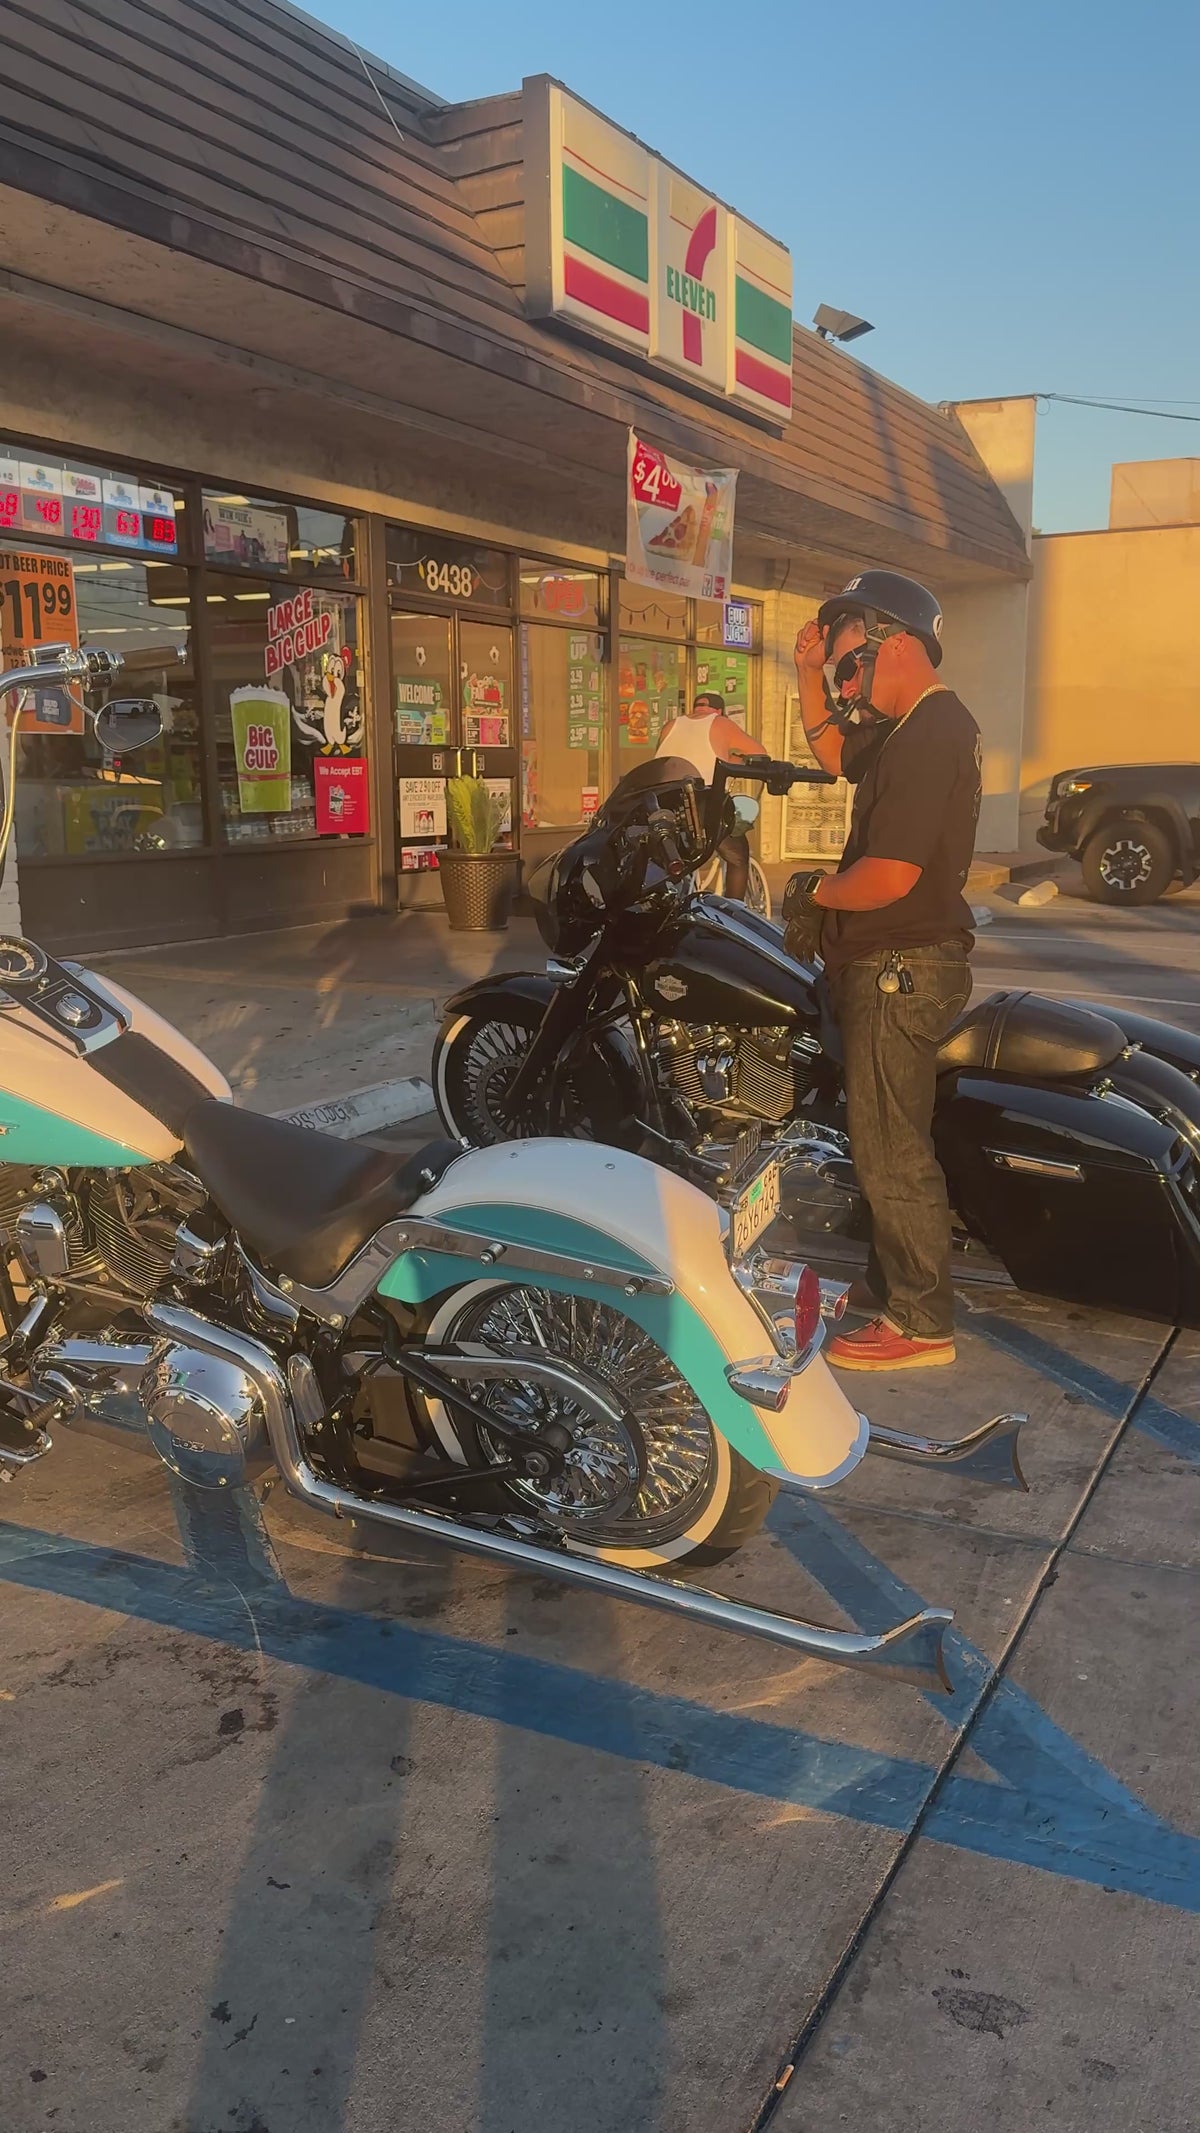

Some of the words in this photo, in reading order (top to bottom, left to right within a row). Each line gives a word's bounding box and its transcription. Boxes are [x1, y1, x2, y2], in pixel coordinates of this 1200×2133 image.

[683, 206, 717, 367] 7
[36, 499, 60, 523] 48
[72, 506, 101, 530] 130
[116, 510, 140, 538] 63
[14, 556, 38, 573] BEER
[40, 558, 70, 578] PRICE
[426, 559, 473, 598] 8438
[267, 588, 314, 642] LARGE
[727, 607, 748, 625] BUD
[264, 634, 295, 678] BIG
[293, 611, 332, 659] GULP
[725, 624, 750, 643] LIGHT
[399, 683, 435, 705] WELCOME
[244, 748, 279, 769] GULP
[330, 766, 351, 778] Accept
[405, 780, 418, 794] SAVE
